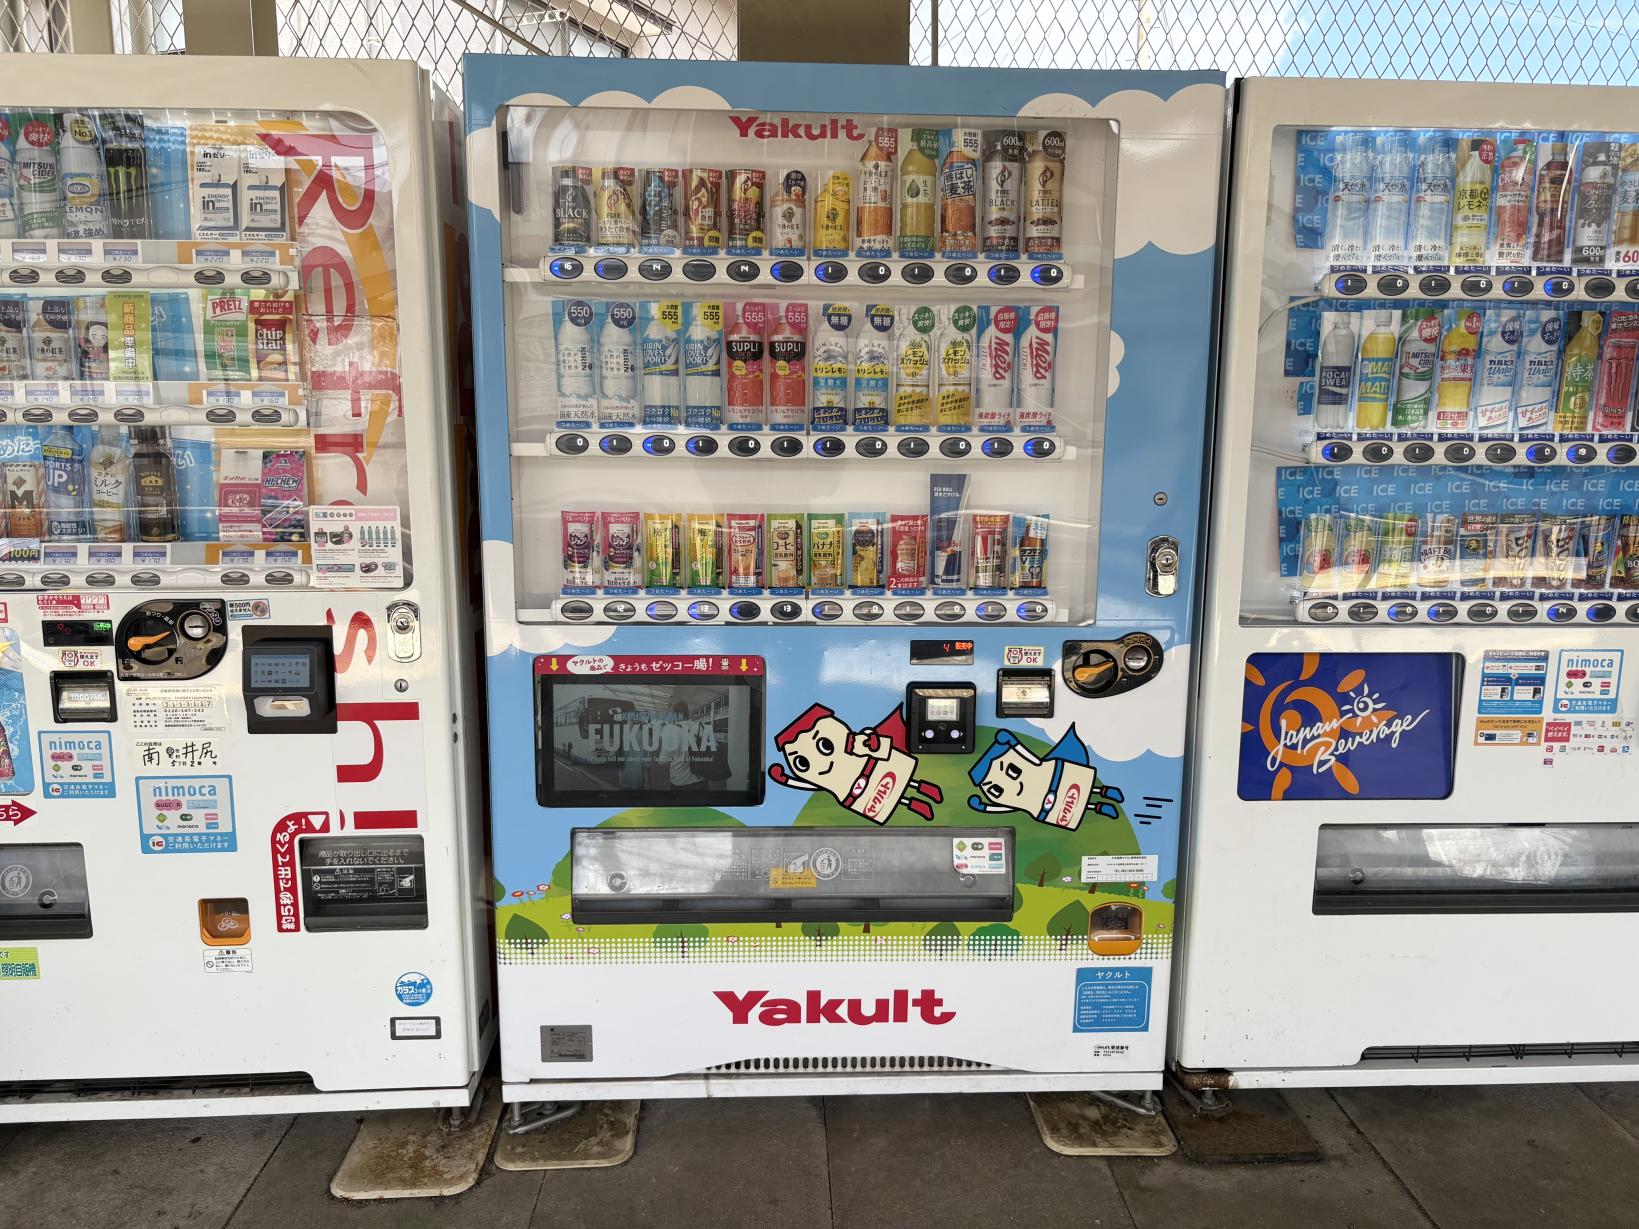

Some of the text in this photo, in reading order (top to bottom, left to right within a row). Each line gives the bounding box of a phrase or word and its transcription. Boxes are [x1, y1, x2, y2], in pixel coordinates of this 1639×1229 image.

[729, 116, 866, 142] Yakult
[878, 137, 895, 148] 555
[963, 138, 979, 148] 555
[1302, 132, 1325, 145] ICE
[1300, 174, 1323, 187] ICE
[947, 180, 974, 196] 麦茶
[202, 195, 216, 211] in
[249, 198, 264, 213] in
[988, 198, 1016, 207] BLACK
[65, 206, 104, 214] LEMON
[555, 208, 589, 219] BLACK
[1298, 215, 1321, 228] ICE
[211, 299, 243, 315] PRETZ
[571, 306, 590, 317] 550
[613, 308, 633, 319] 550
[661, 311, 679, 320] 555
[703, 311, 720, 320] 555
[744, 312, 765, 322] 555
[788, 312, 807, 323] 555
[830, 316, 849, 326] 無糖
[873, 317, 891, 327] 無糖
[123, 302, 136, 369] 新商品準備中
[257, 327, 284, 340] chip
[257, 339, 284, 350] star
[732, 342, 758, 351] SUPLI
[775, 343, 801, 352] SUPLI
[904, 350, 925, 358] レモン
[993, 335, 1013, 381] Mets
[1034, 335, 1053, 381] Mets
[1567, 364, 1595, 381] 特茶
[977, 411, 1011, 420] 強炭酸ライチ
[1018, 411, 1052, 420] 強炭酸ライチ
[1318, 465, 1417, 479] ICE ICE ICE
[93, 476, 122, 489] ミルク
[263, 476, 301, 489] HI-CHEW
[1335, 479, 1607, 497] ICE ICE ICE ICE ICE ICE
[95, 489, 119, 497] コーヒー
[772, 541, 794, 551] コーヒー
[813, 541, 833, 550] バナナ
[572, 658, 604, 666] ヤクルトの
[618, 658, 713, 671] きょうも ゼッコー腸!
[1026, 656, 1038, 664] OK
[1566, 655, 1614, 668] nimoca
[48, 737, 103, 750] nimoca
[588, 722, 718, 752] FUKUOKA
[1267, 713, 1353, 772] Japan
[1304, 709, 1431, 775] Beverage
[143, 746, 160, 767] 南
[152, 781, 217, 797] nimoca
[867, 781, 891, 815] ヤクルト
[1058, 790, 1077, 824] ヤクルト
[1095, 970, 1131, 979] ヤクルト
[712, 988, 957, 1027] Yakult
